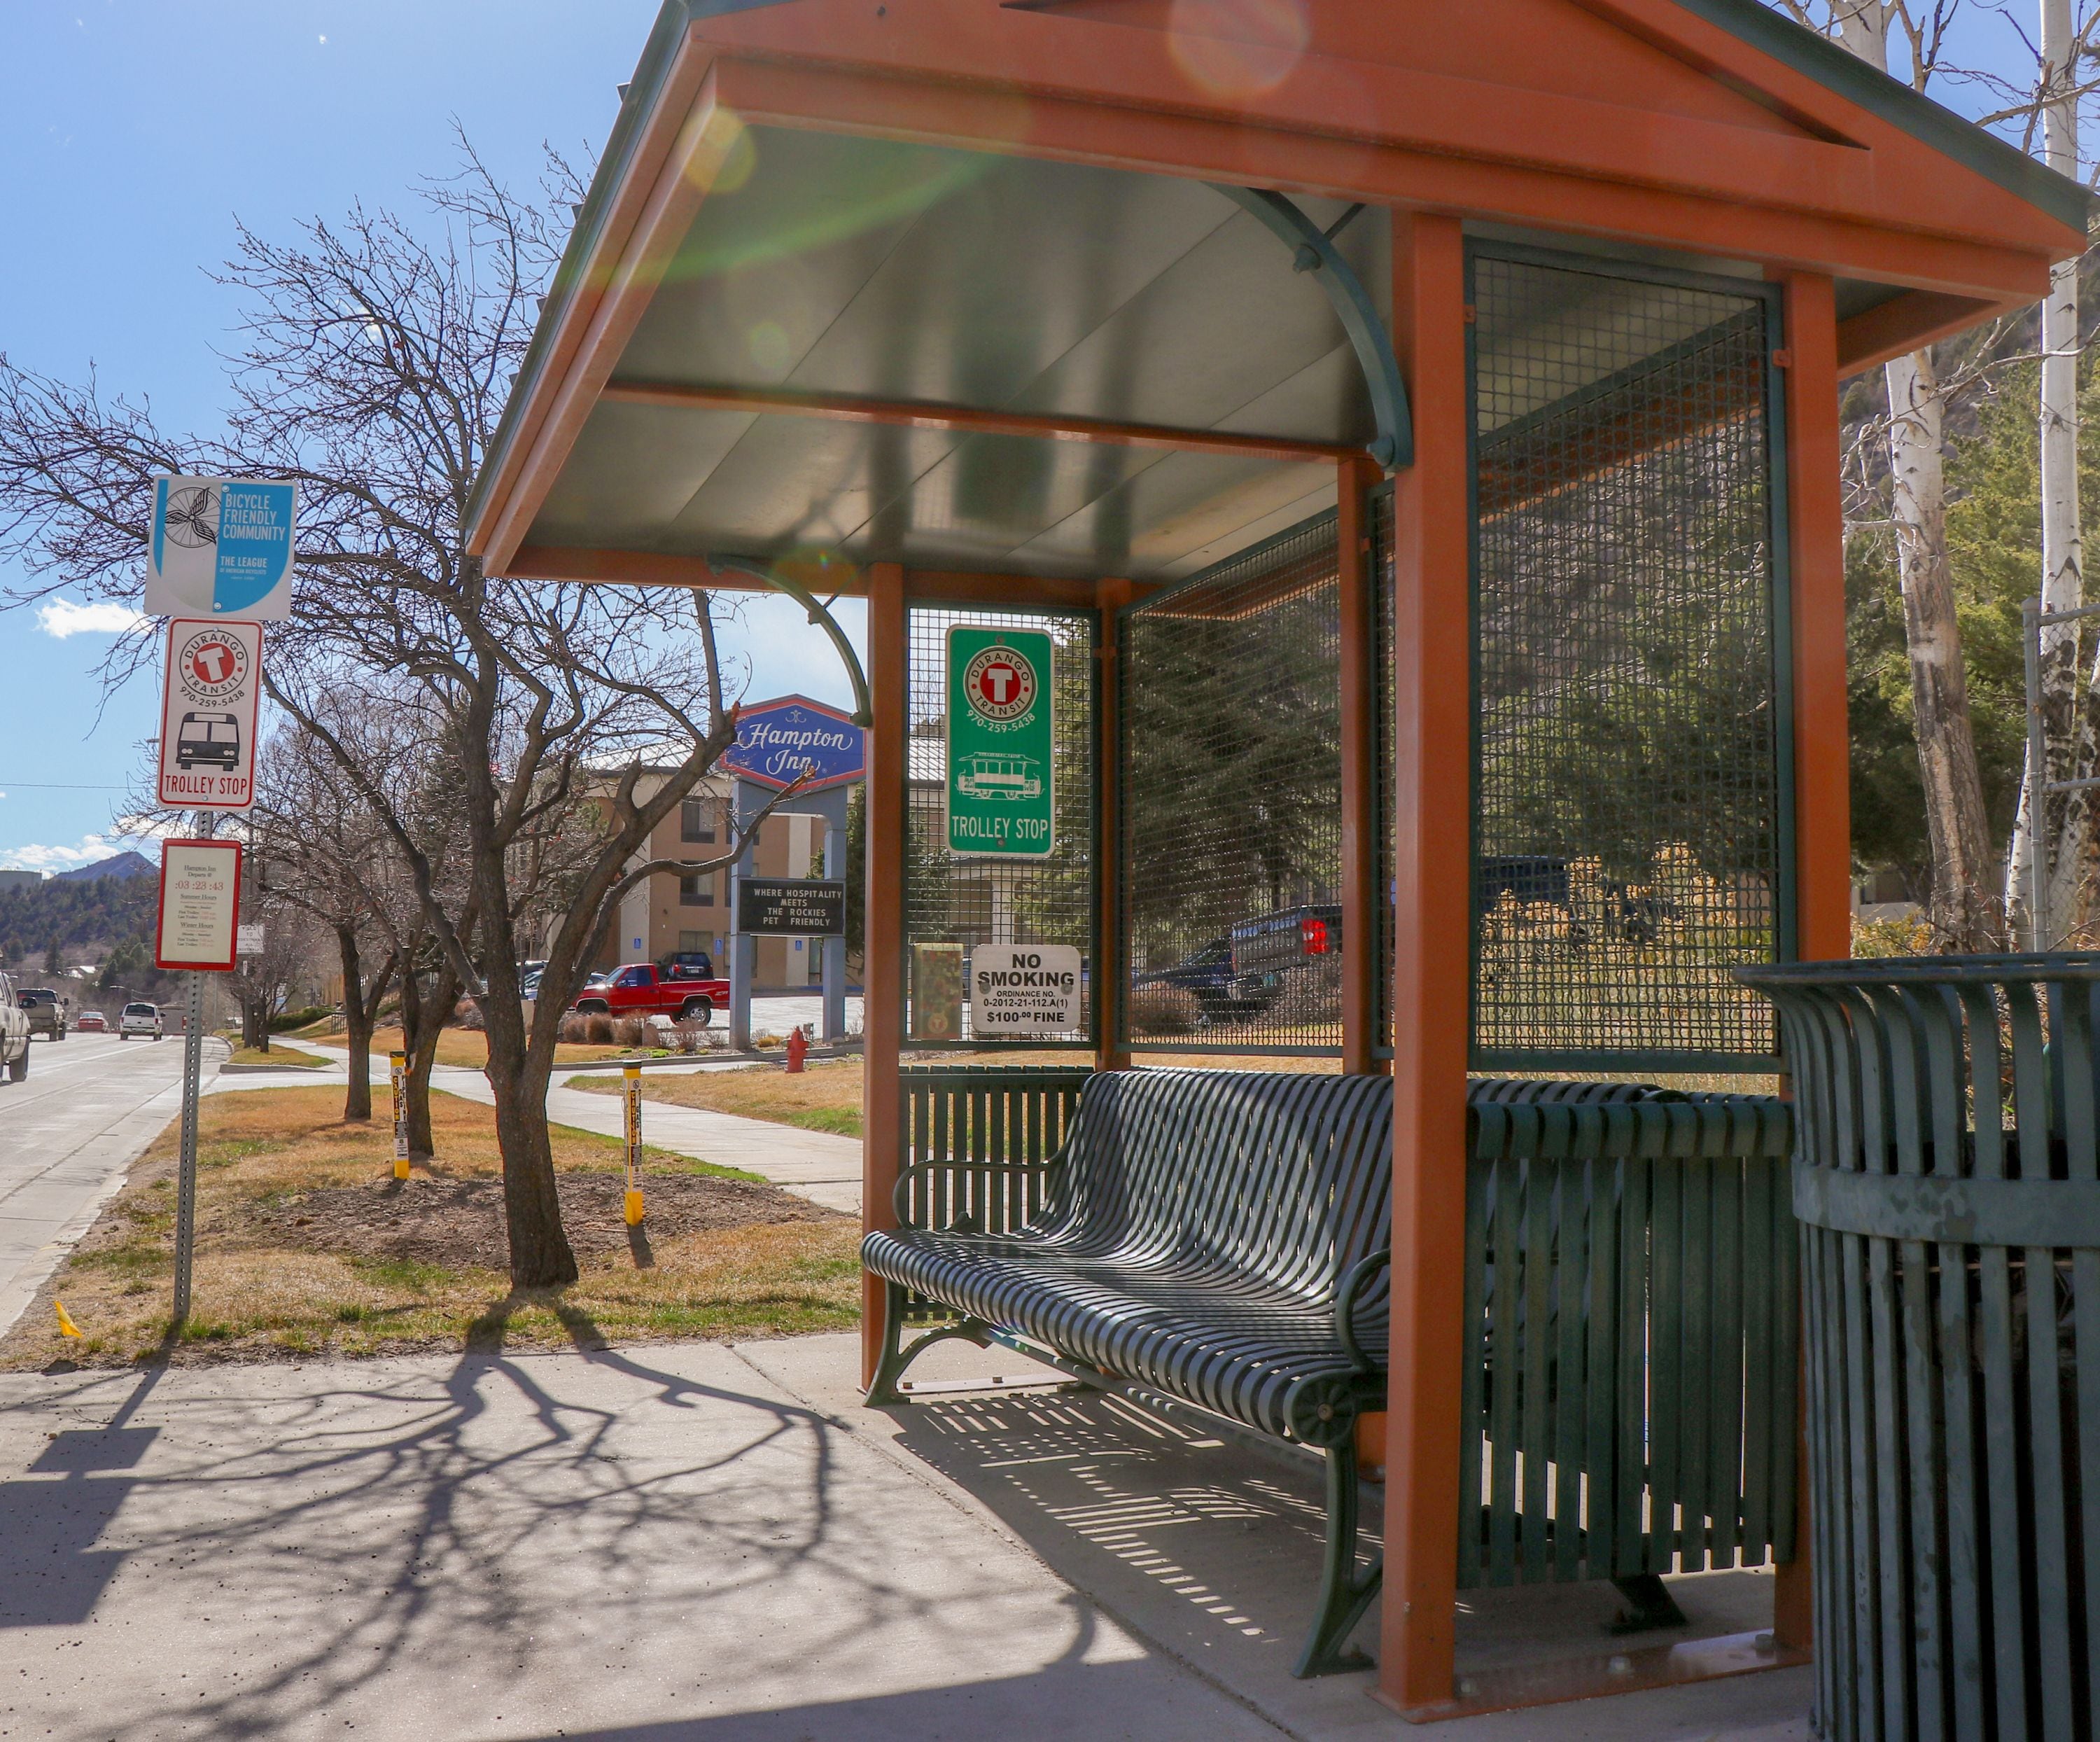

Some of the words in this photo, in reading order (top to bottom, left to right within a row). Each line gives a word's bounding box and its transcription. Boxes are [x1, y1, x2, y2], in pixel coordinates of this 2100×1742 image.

[225, 494, 270, 510] BICYCLE
[224, 509, 277, 524] FRIENDLY
[223, 524, 286, 541] COMMUNITY
[220, 556, 235, 566] THE
[238, 557, 267, 568] LEAGUE
[185, 634, 244, 660] DURANGO
[197, 646, 224, 682] T
[971, 652, 1030, 681] DURANGO
[187, 674, 239, 693] TRANSIT
[988, 668, 1013, 702] T
[180, 686, 244, 707] 970-259-5438
[976, 695, 1024, 716] TRANSIT
[966, 709, 1035, 733] 970-259-5438
[738, 723, 853, 752] Hampton
[766, 749, 820, 775] Inn
[165, 775, 214, 794] TROLLEY
[219, 777, 247, 795] STOP
[952, 816, 1010, 839] TROLLEY
[1016, 818, 1049, 839] STOP
[754, 889, 782, 898] WHERE
[786, 889, 842, 899] HOSPITALITY
[780, 898, 807, 907] MEETS
[767, 907, 783, 917] THE
[790, 908, 826, 917] ROCKIES
[763, 917, 778, 926] PET
[790, 917, 830, 927] FRIENDLY
[1012, 954, 1041, 969] NO
[978, 971, 1074, 987] SMOKING
[1033, 1012, 1065, 1022] FINE
